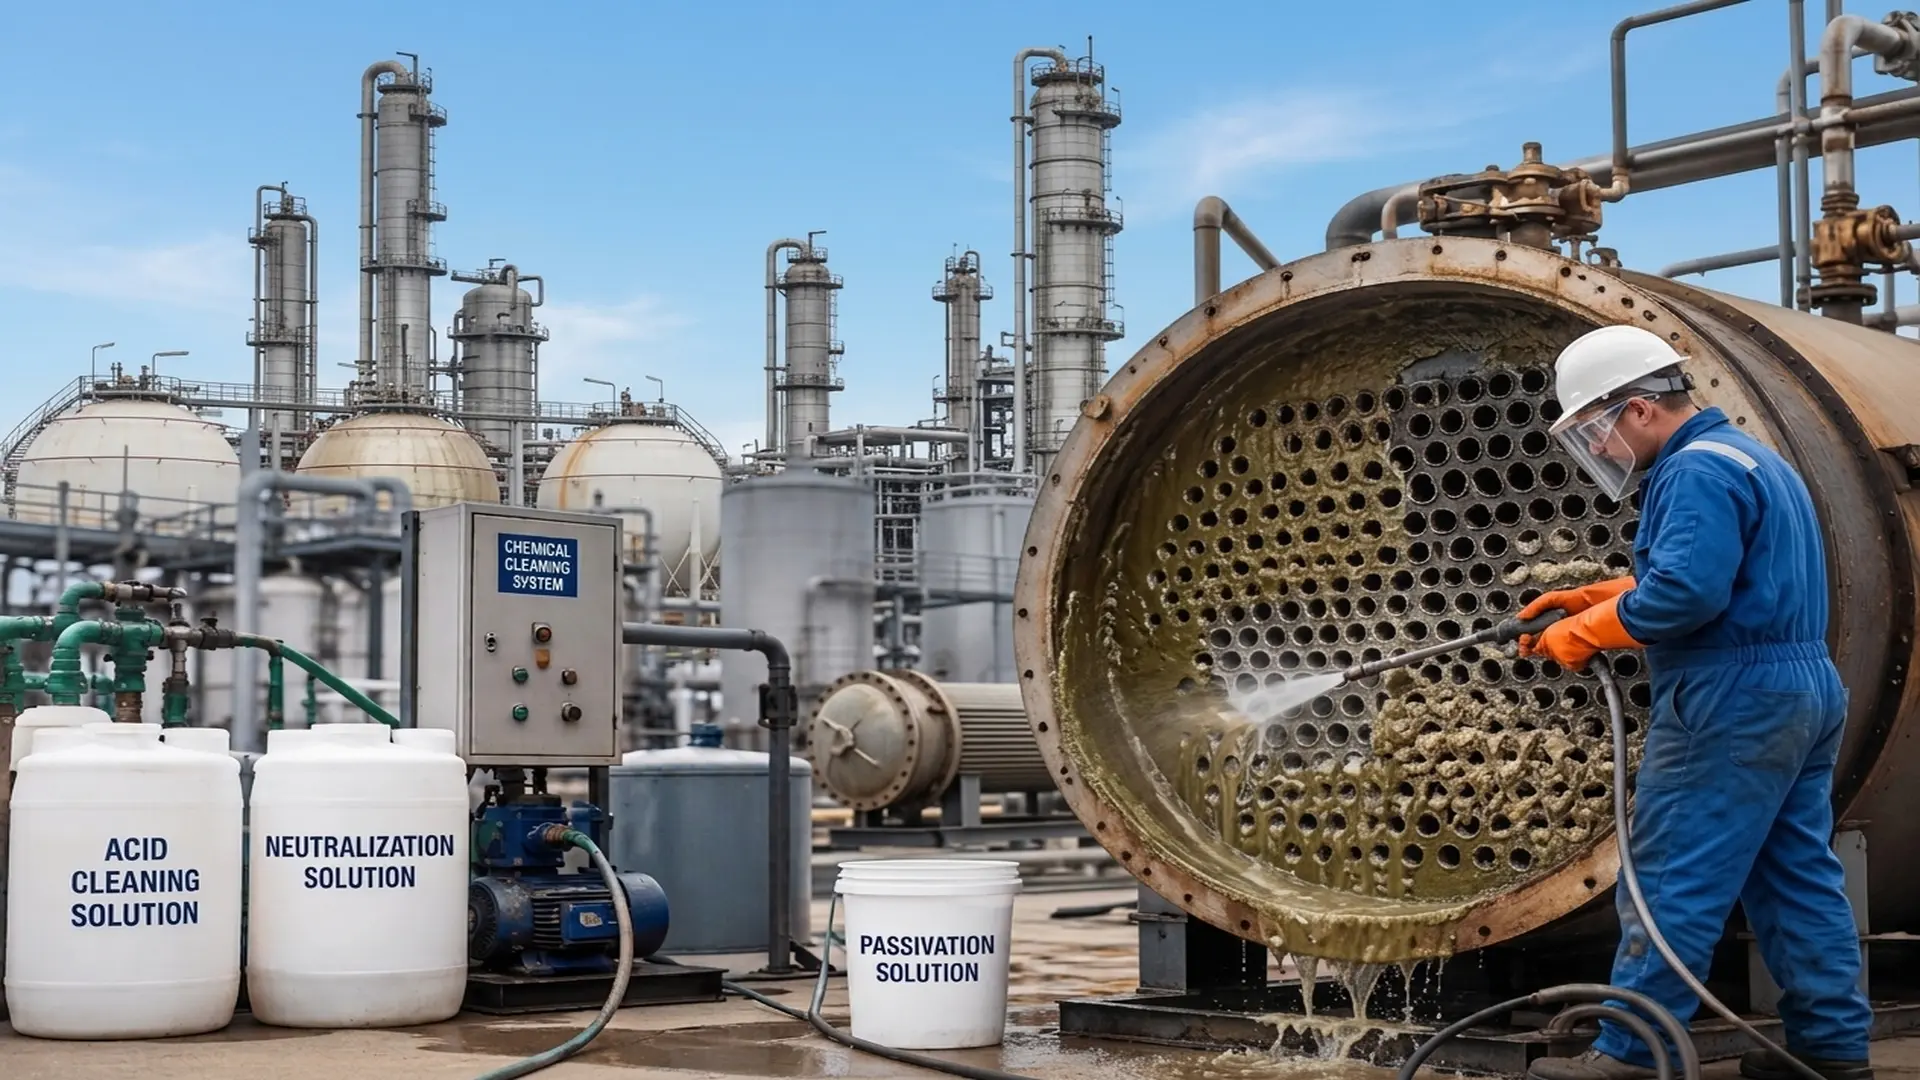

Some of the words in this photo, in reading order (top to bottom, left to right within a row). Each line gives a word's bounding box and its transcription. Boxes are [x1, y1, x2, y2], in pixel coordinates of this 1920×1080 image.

[505, 539, 571, 558] CHEMICAL
[512, 574, 564, 591] SYSTEM
[104, 837, 168, 861] ACID
[266, 834, 454, 857] NEUTRALIZATION
[71, 869, 200, 894] CLEANING
[304, 865, 416, 888] SOLUTION
[71, 901, 199, 927] SOLUTION
[860, 934, 995, 956] PASSIVATION
[875, 962, 979, 982] SOLUTION
